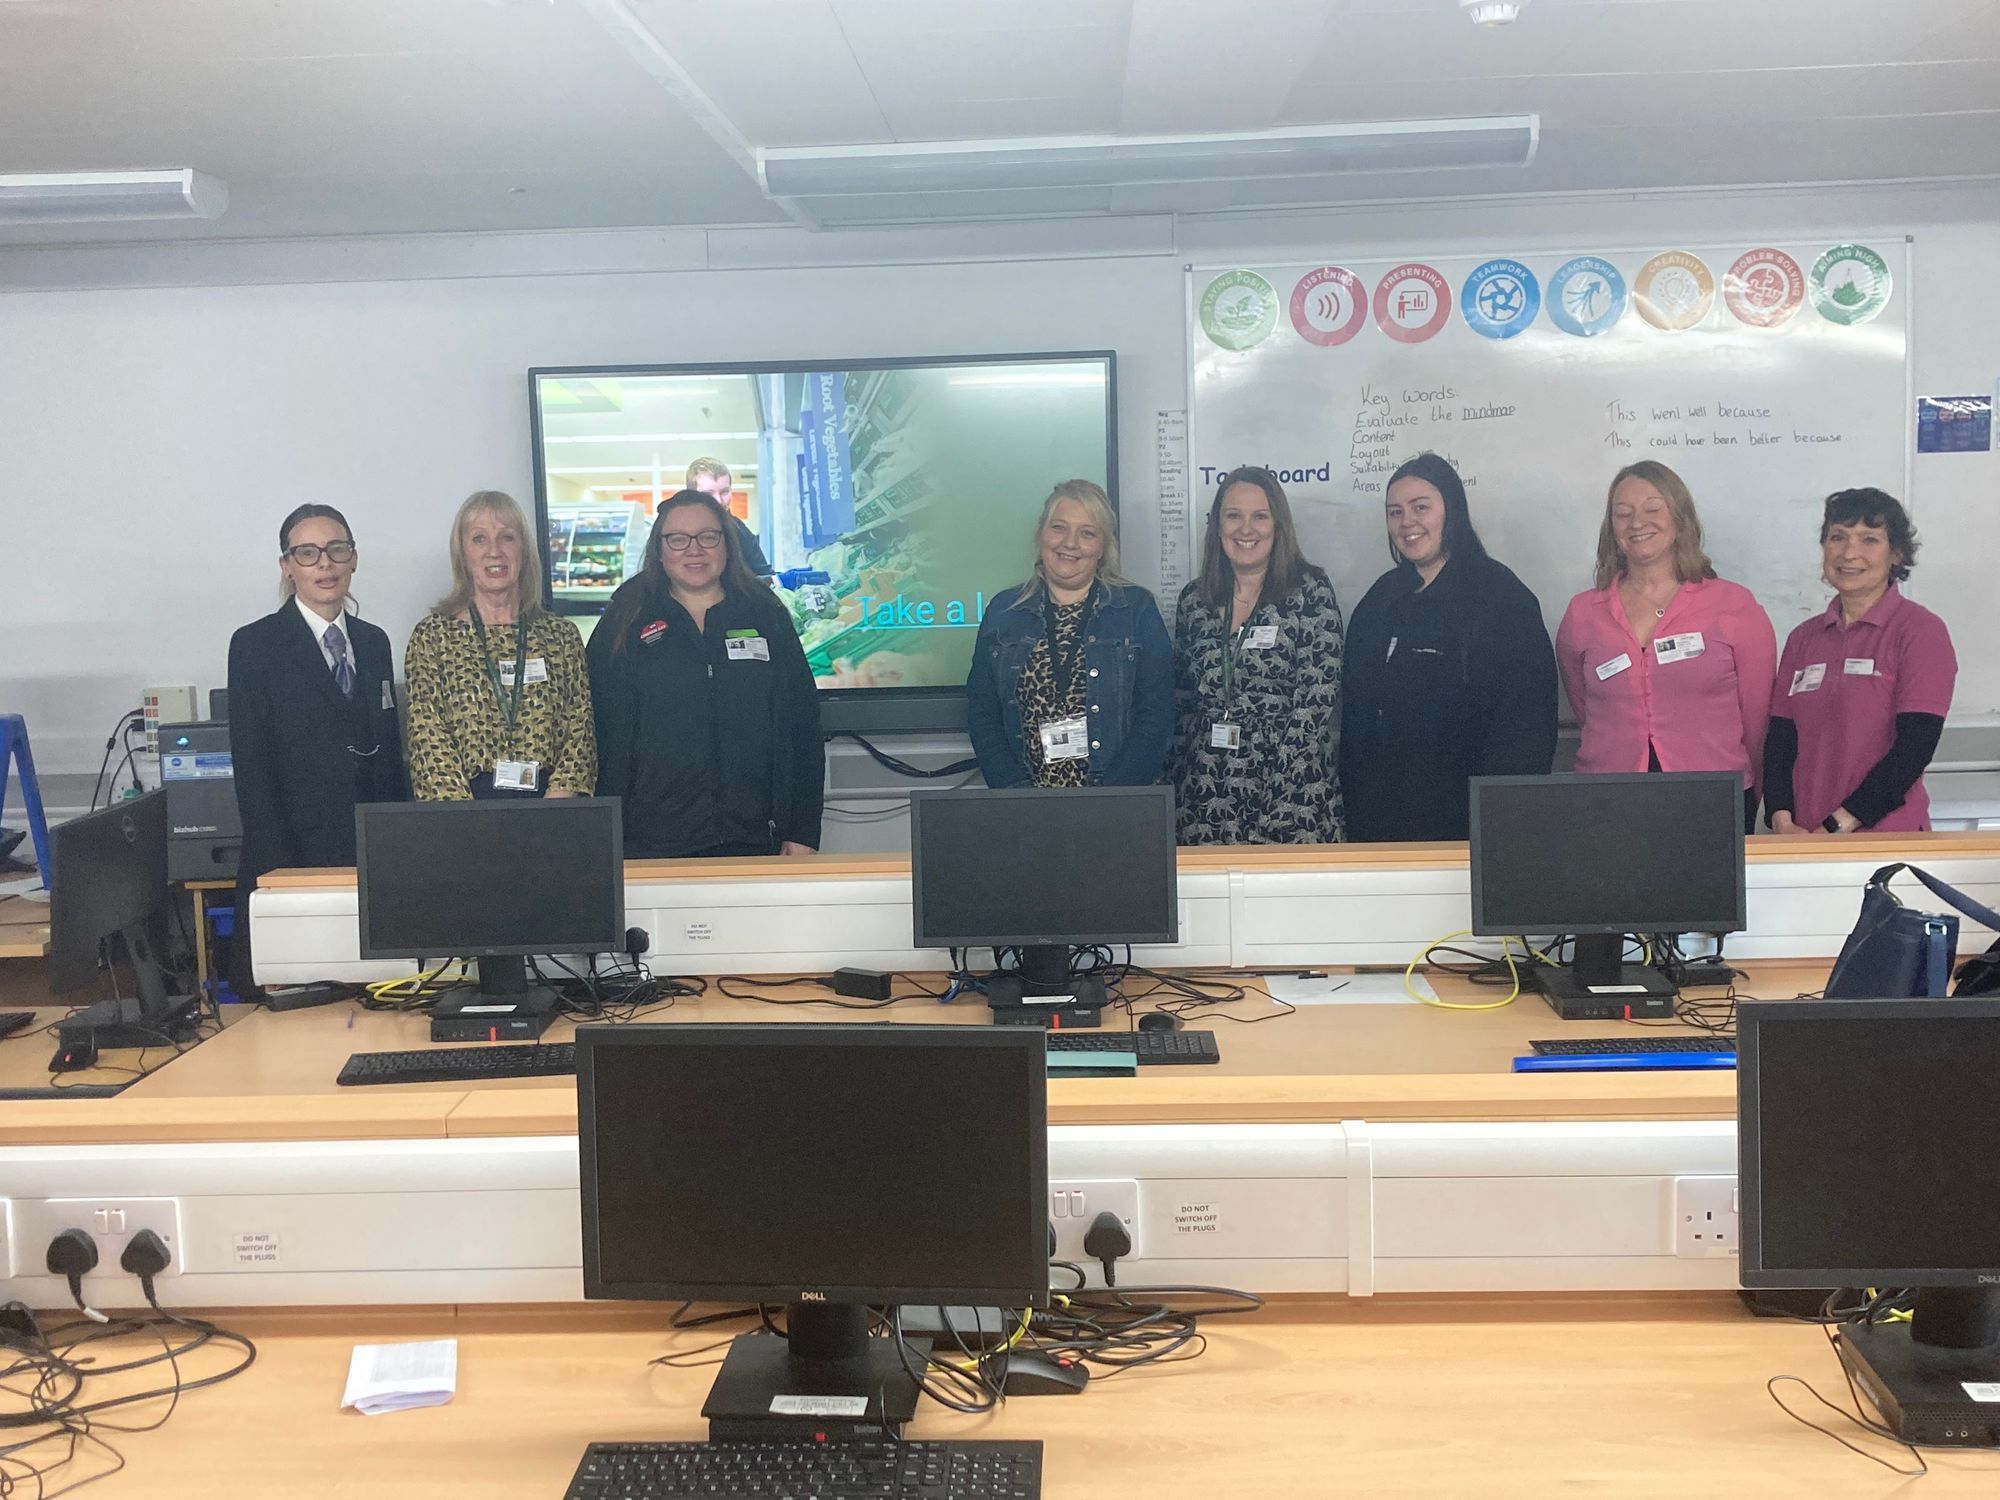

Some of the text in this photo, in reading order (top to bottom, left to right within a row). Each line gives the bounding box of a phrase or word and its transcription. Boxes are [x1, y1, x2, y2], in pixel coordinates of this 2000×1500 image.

[1649, 255, 1705, 276] CREATIVITY
[1819, 248, 1851, 272] AIMING
[1303, 271, 1354, 290] LISTENING
[1383, 267, 1443, 290] PRESENTING
[1472, 263, 1529, 282] TEAMWORK
[1557, 260, 1617, 284] LEADERSHIP
[1777, 256, 1801, 296] SOLVING
[1361, 383, 1391, 416] Key
[1606, 399, 1636, 422] This
[1688, 406, 1707, 418] well
[1718, 401, 1771, 419] because
[1355, 402, 1517, 428] Evaluate the mindmap
[819, 374, 844, 500] Root Vegetables
[1352, 429, 1396, 444] Content
[1604, 429, 1842, 449] This could have been better because
[1350, 443, 1390, 467] Layout
[1352, 477, 1381, 492] Areas
[854, 592, 936, 625] Take
[946, 600, 966, 625] a
[1193, 1224, 1216, 1232] PLUGS
[1978, 1275, 2000, 1284] DEL
[802, 1291, 826, 1301] DELL
